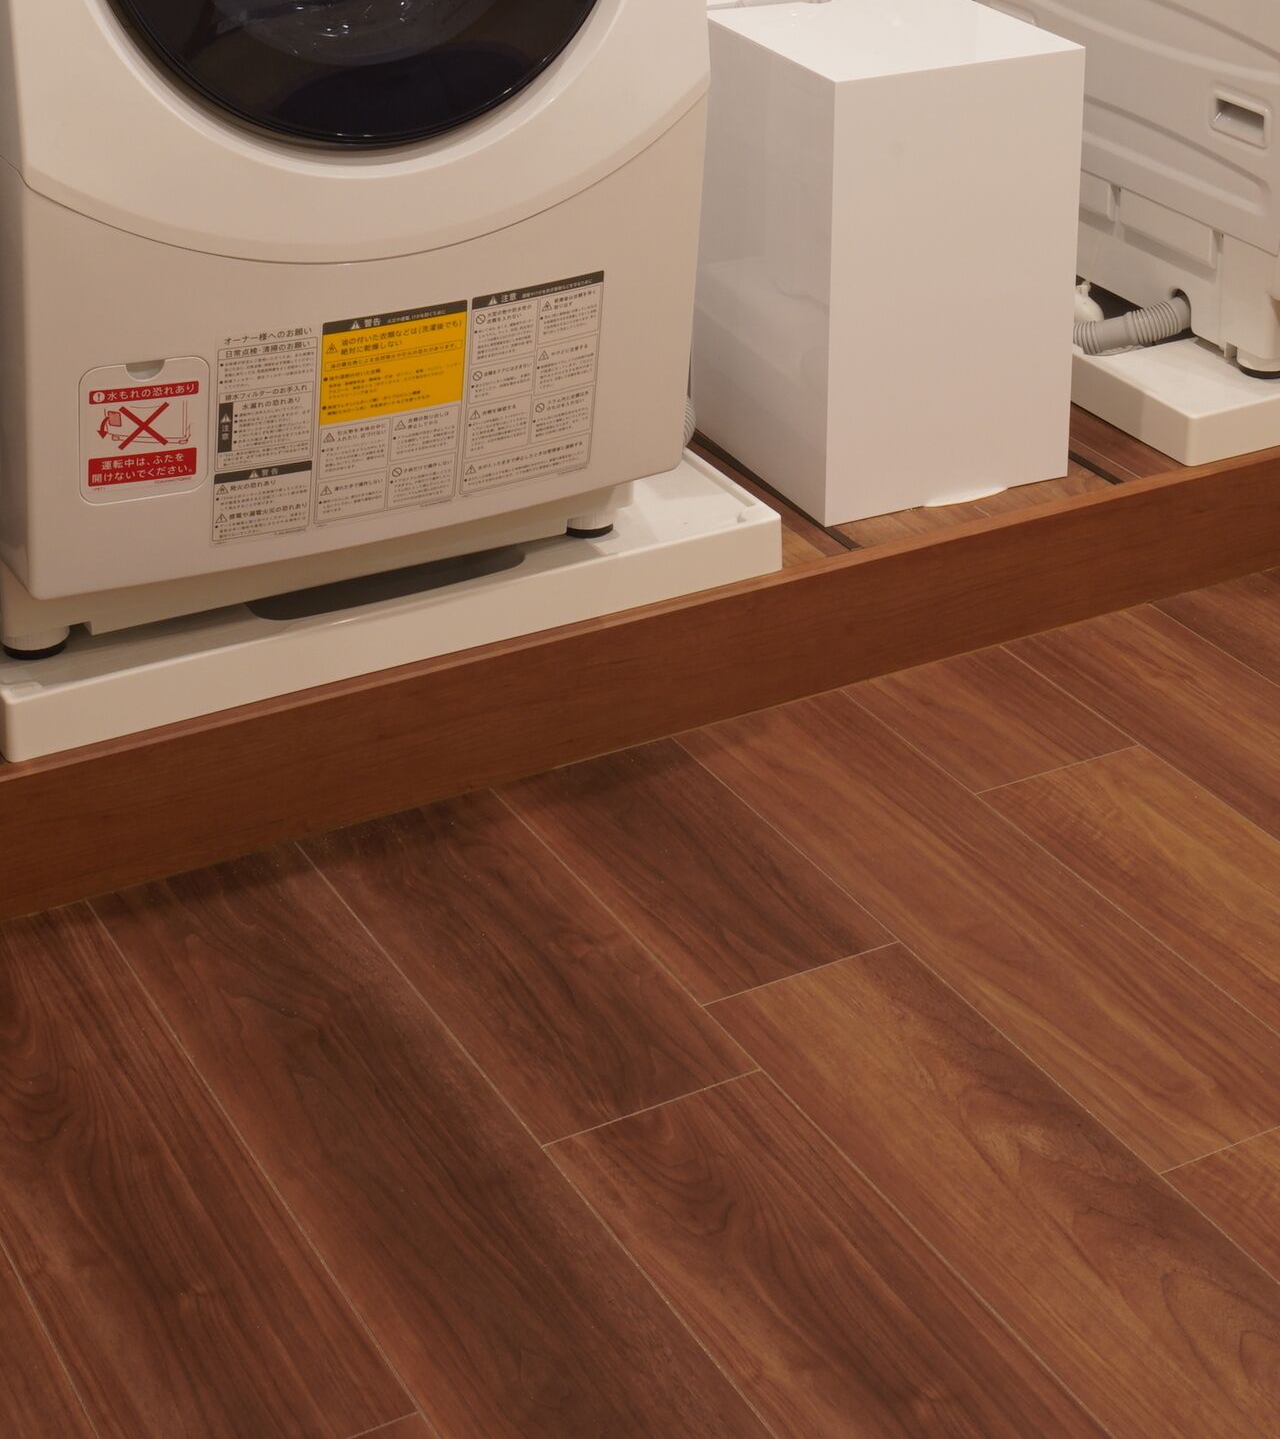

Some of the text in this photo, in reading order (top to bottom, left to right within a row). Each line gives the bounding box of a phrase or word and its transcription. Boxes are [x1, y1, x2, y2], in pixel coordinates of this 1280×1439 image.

[107, 384, 194, 401] 水もれの恐れあり
